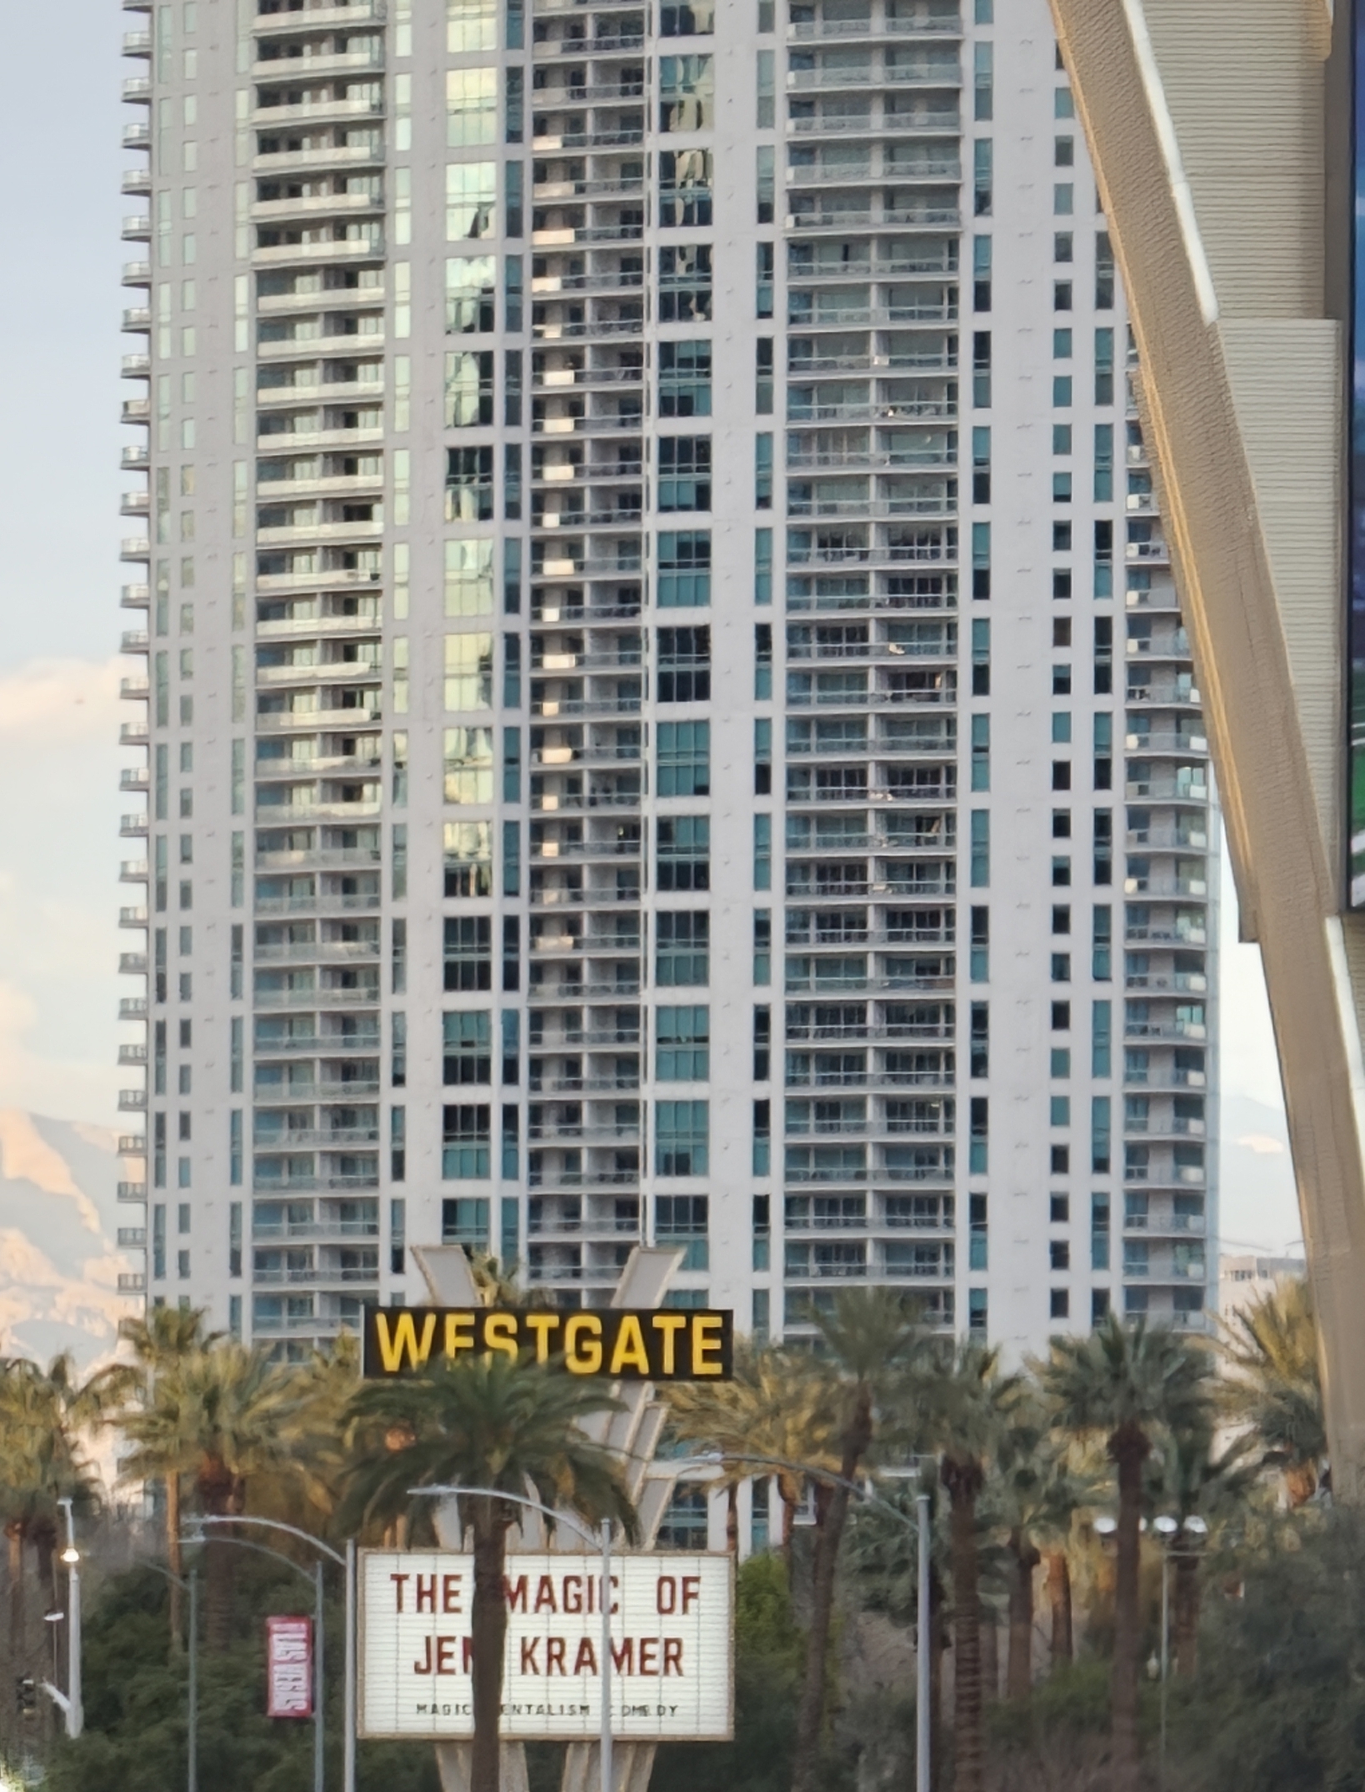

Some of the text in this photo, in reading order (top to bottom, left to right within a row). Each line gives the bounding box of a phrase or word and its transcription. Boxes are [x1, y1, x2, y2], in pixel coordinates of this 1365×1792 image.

[375, 1312, 724, 1376] WESTGATE
[390, 1573, 702, 1615] THE MAGIC OF
[520, 1636, 684, 1677] KRAMER
[500, 1704, 591, 1717] ENTALISM
